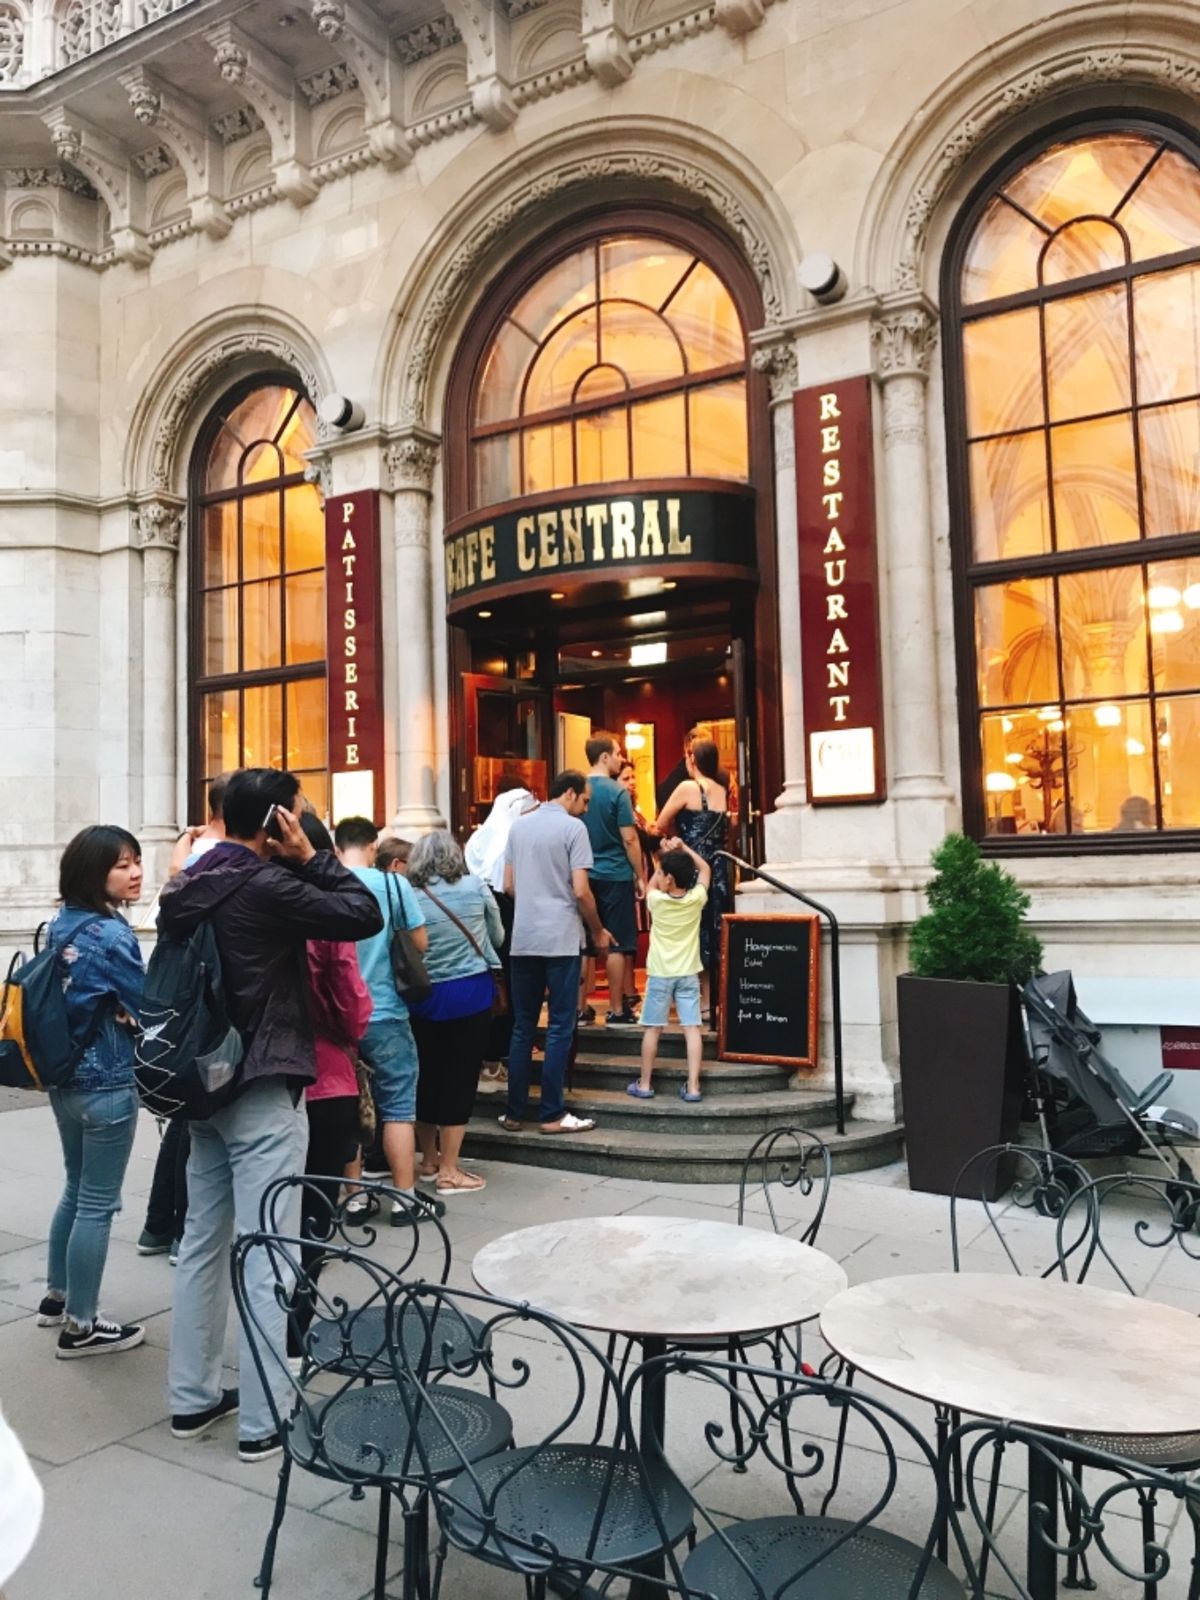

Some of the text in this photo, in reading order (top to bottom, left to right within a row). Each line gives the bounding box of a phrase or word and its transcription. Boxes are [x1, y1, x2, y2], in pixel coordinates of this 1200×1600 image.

[341, 502, 359, 764] PATISSERIE
[516, 498, 691, 572] CENTRAL
[819, 392, 850, 722] RESTAURANT
